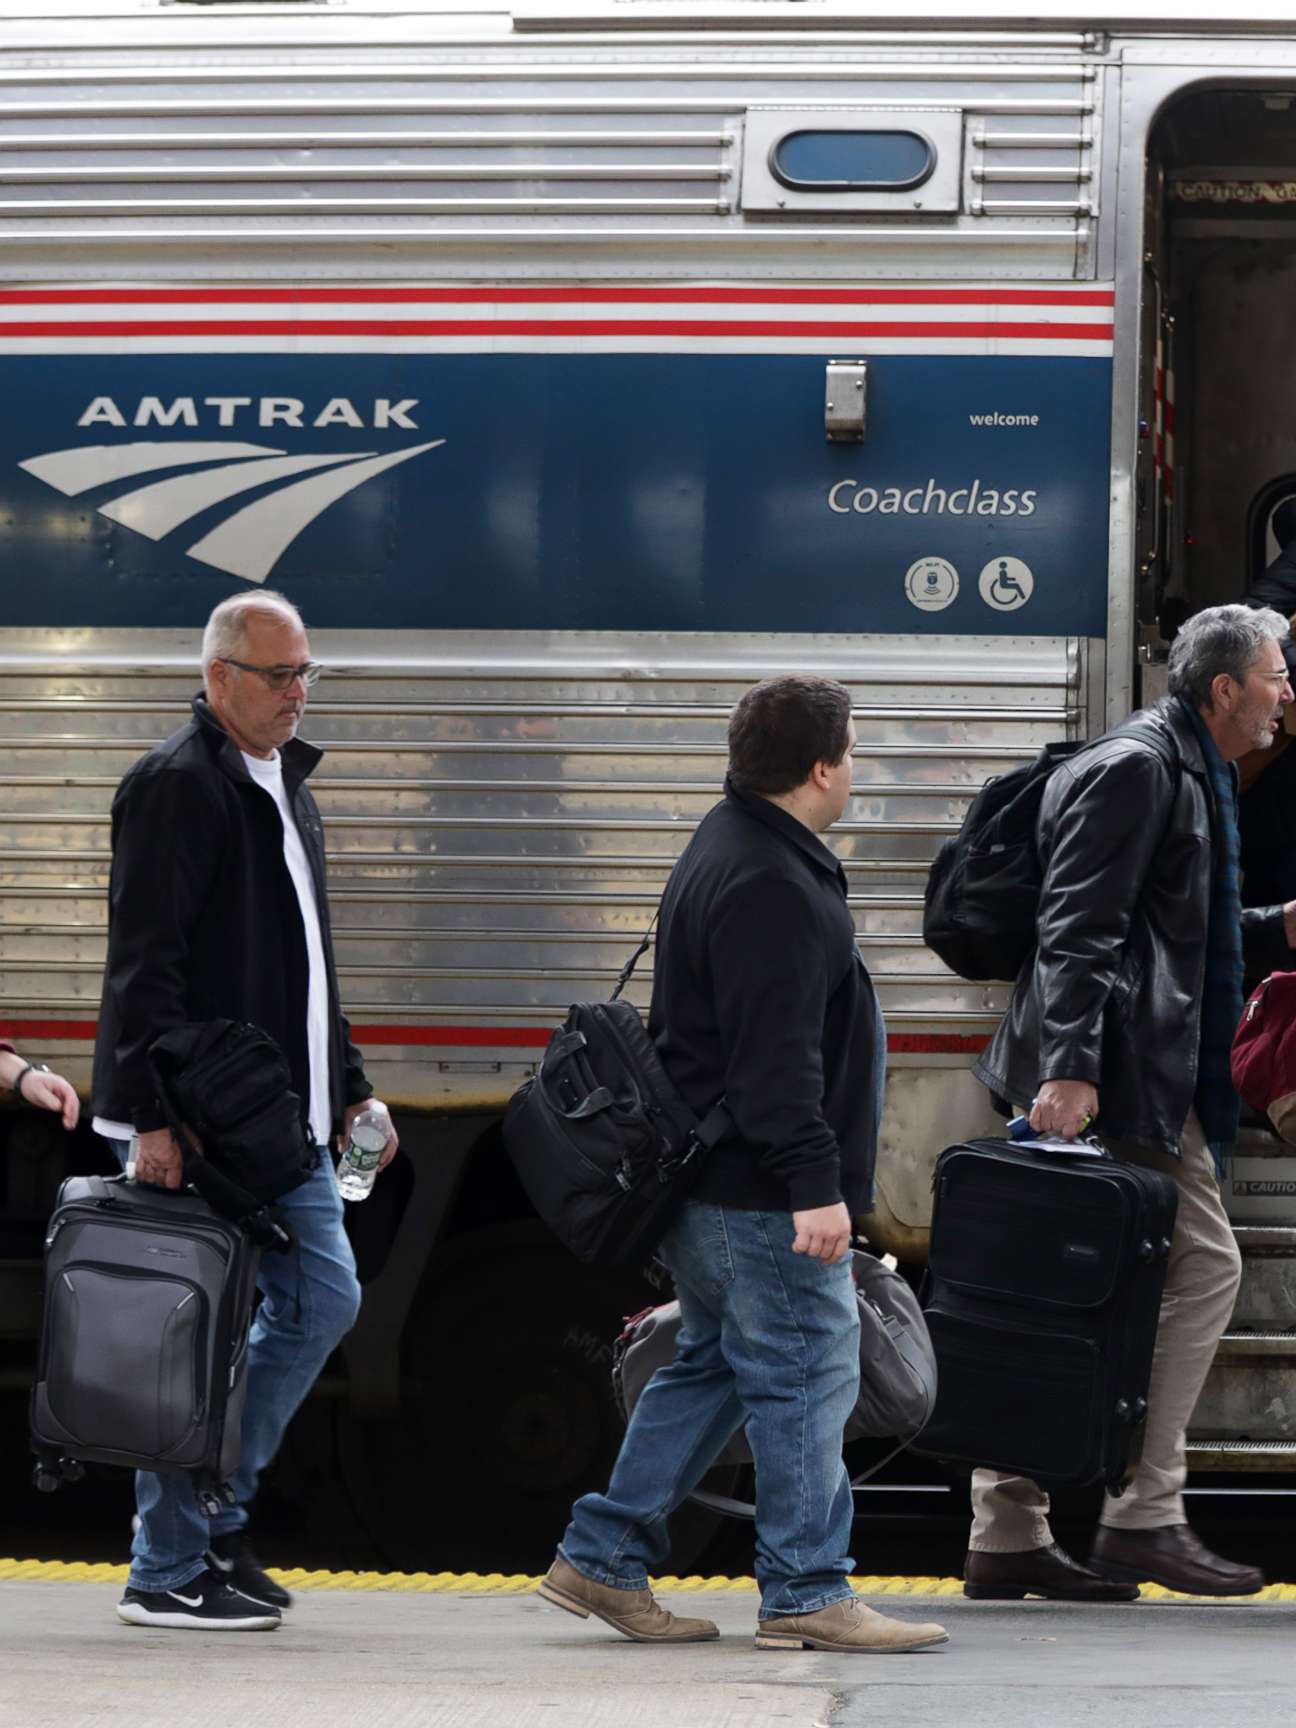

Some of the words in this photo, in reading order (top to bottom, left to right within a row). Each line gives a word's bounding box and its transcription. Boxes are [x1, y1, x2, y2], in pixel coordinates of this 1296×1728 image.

[78, 396, 420, 430] AMTRAK
[969, 411, 1039, 427] welcome
[827, 478, 1038, 516] Coachclass
